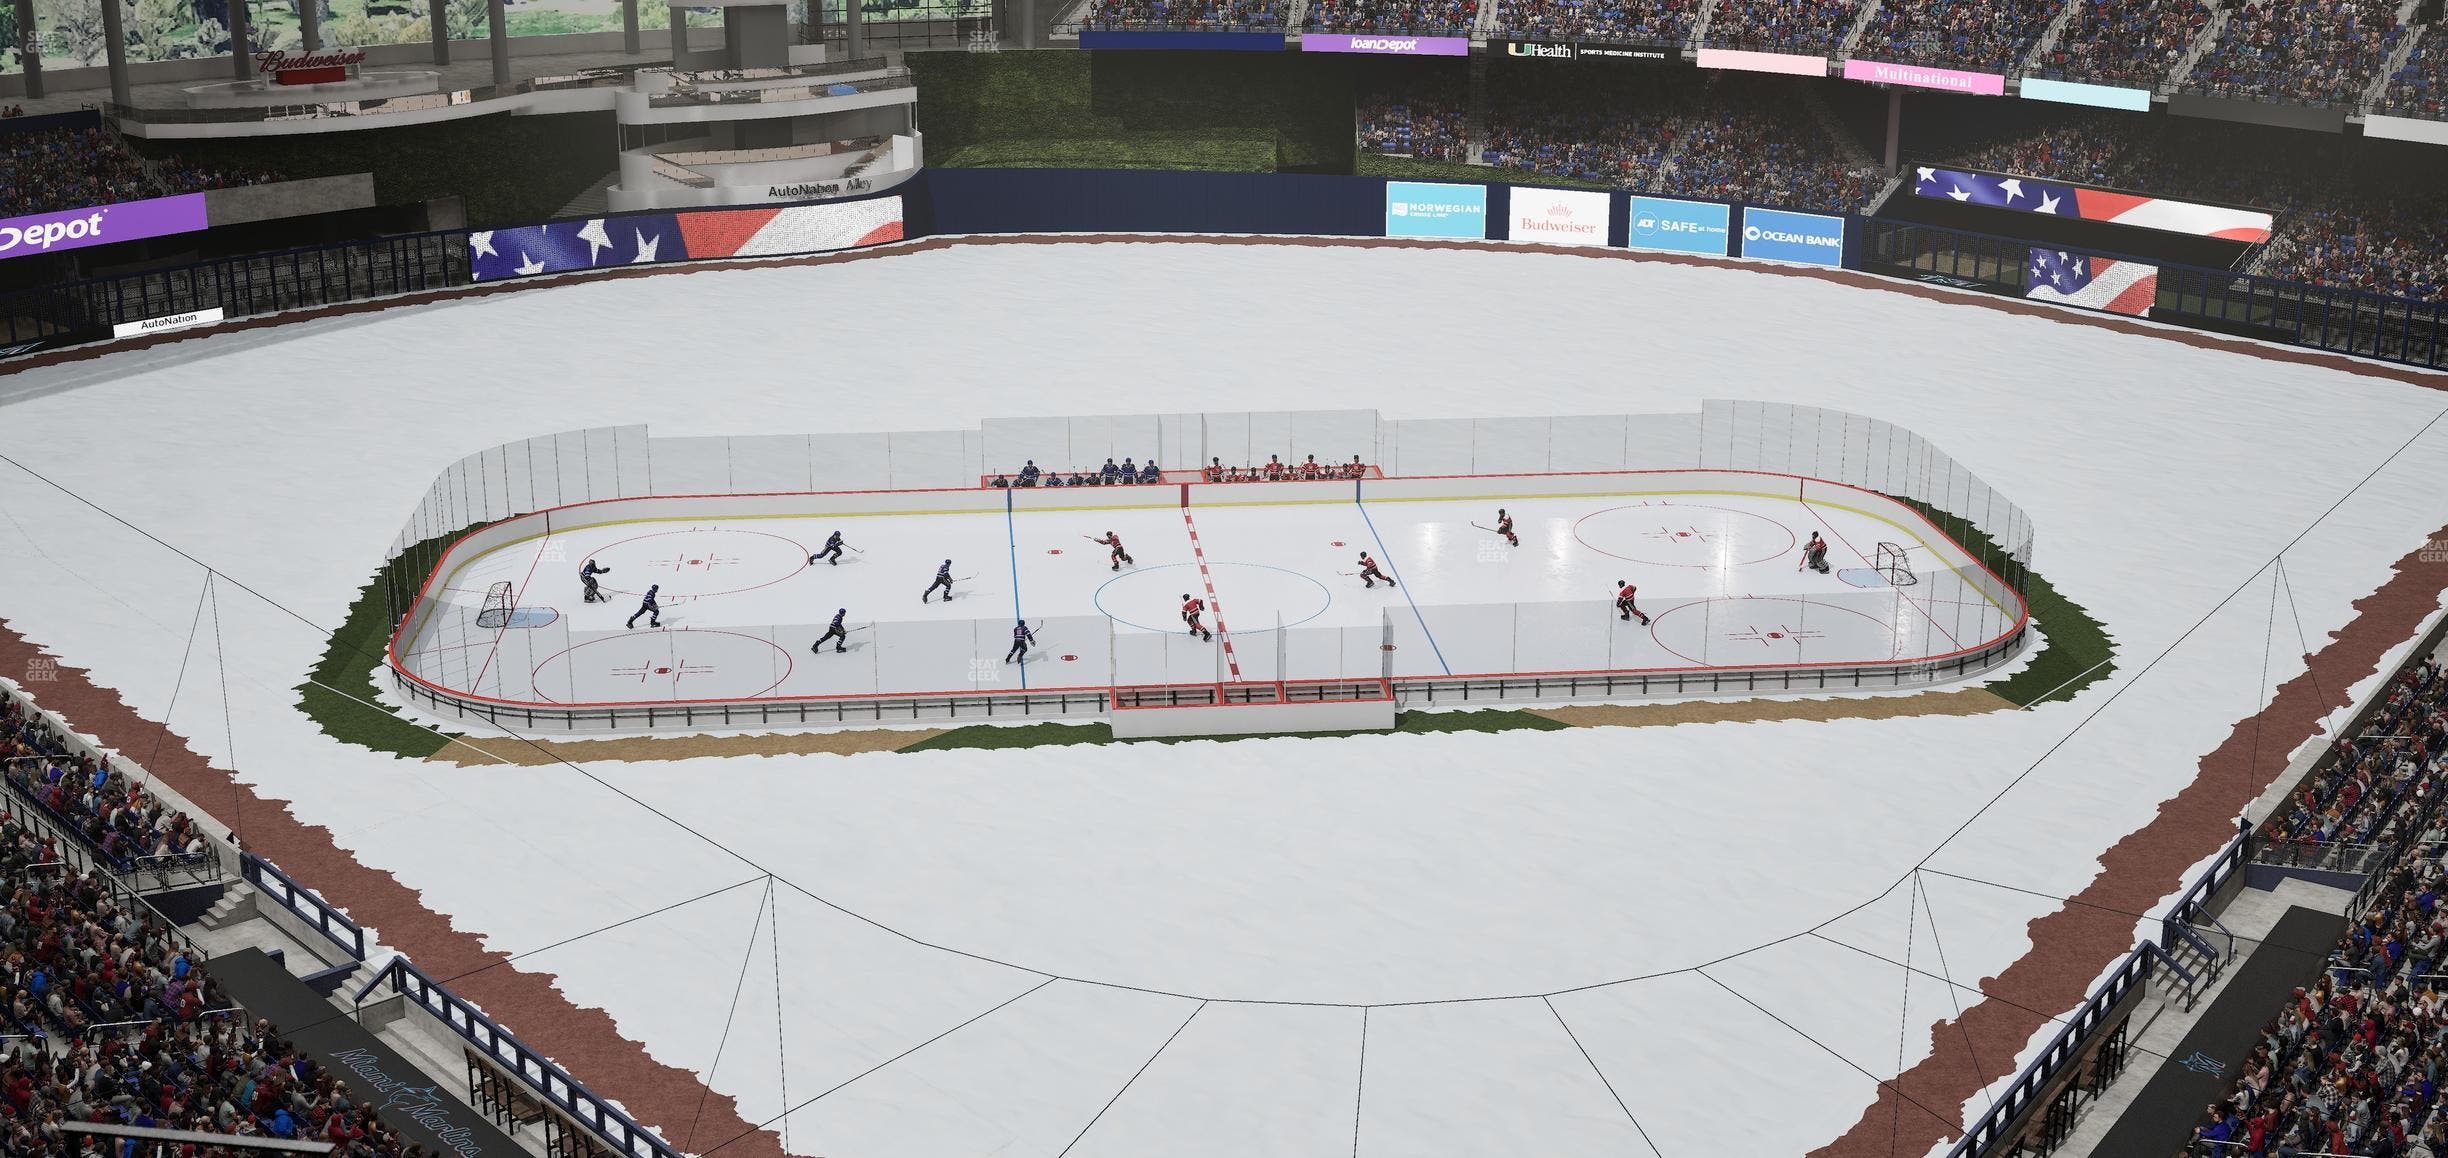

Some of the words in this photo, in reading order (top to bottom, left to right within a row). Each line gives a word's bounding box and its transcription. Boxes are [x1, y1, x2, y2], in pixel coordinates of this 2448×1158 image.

[1350, 36, 1418, 53] loanDepot
[256, 49, 368, 73] Budweiser
[1603, 50, 1633, 58] MEDICINE
[1633, 51, 1665, 59] INSTITUTE
[1874, 65, 1973, 89] Multinational
[1409, 202, 1481, 214] NORWEGIAN
[1521, 217, 1597, 235] Budweiser
[1636, 217, 1656, 229] ADT
[1660, 219, 1698, 234] SAFE
[1697, 225, 1706, 233] at
[1706, 225, 1727, 235] home
[1762, 230, 1804, 244] OCEAN
[1806, 235, 1842, 248] BANK
[140, 312, 198, 331] AutoNation
[329, 1047, 406, 1093] Miami
[398, 1101, 483, 1158] Marlins
